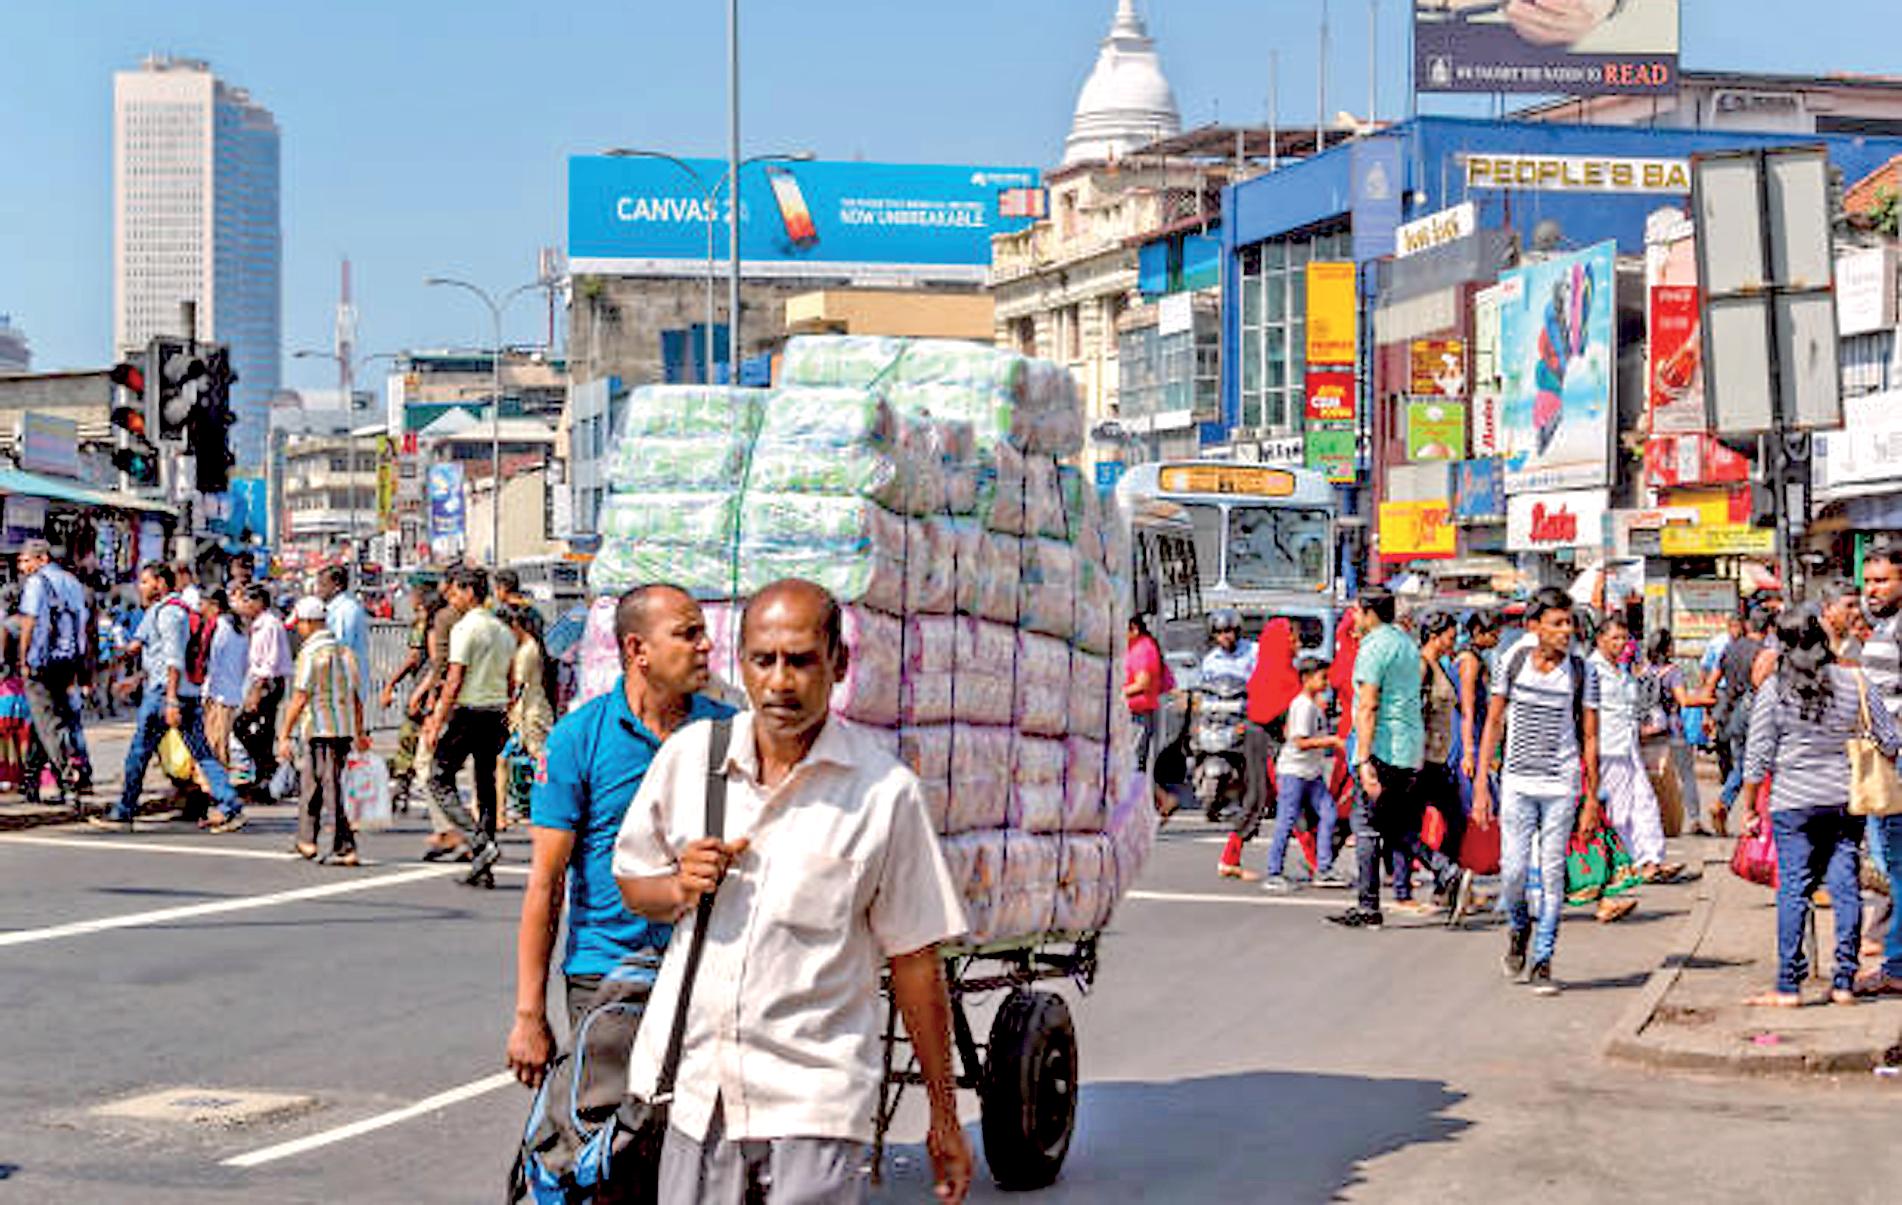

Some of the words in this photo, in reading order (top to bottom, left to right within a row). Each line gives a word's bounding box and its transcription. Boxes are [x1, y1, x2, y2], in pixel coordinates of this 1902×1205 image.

[1603, 63, 1668, 86] READ
[1469, 158, 1632, 187] PEOPLE'S
[617, 197, 718, 222] CANVAS
[841, 209, 874, 225] NOW
